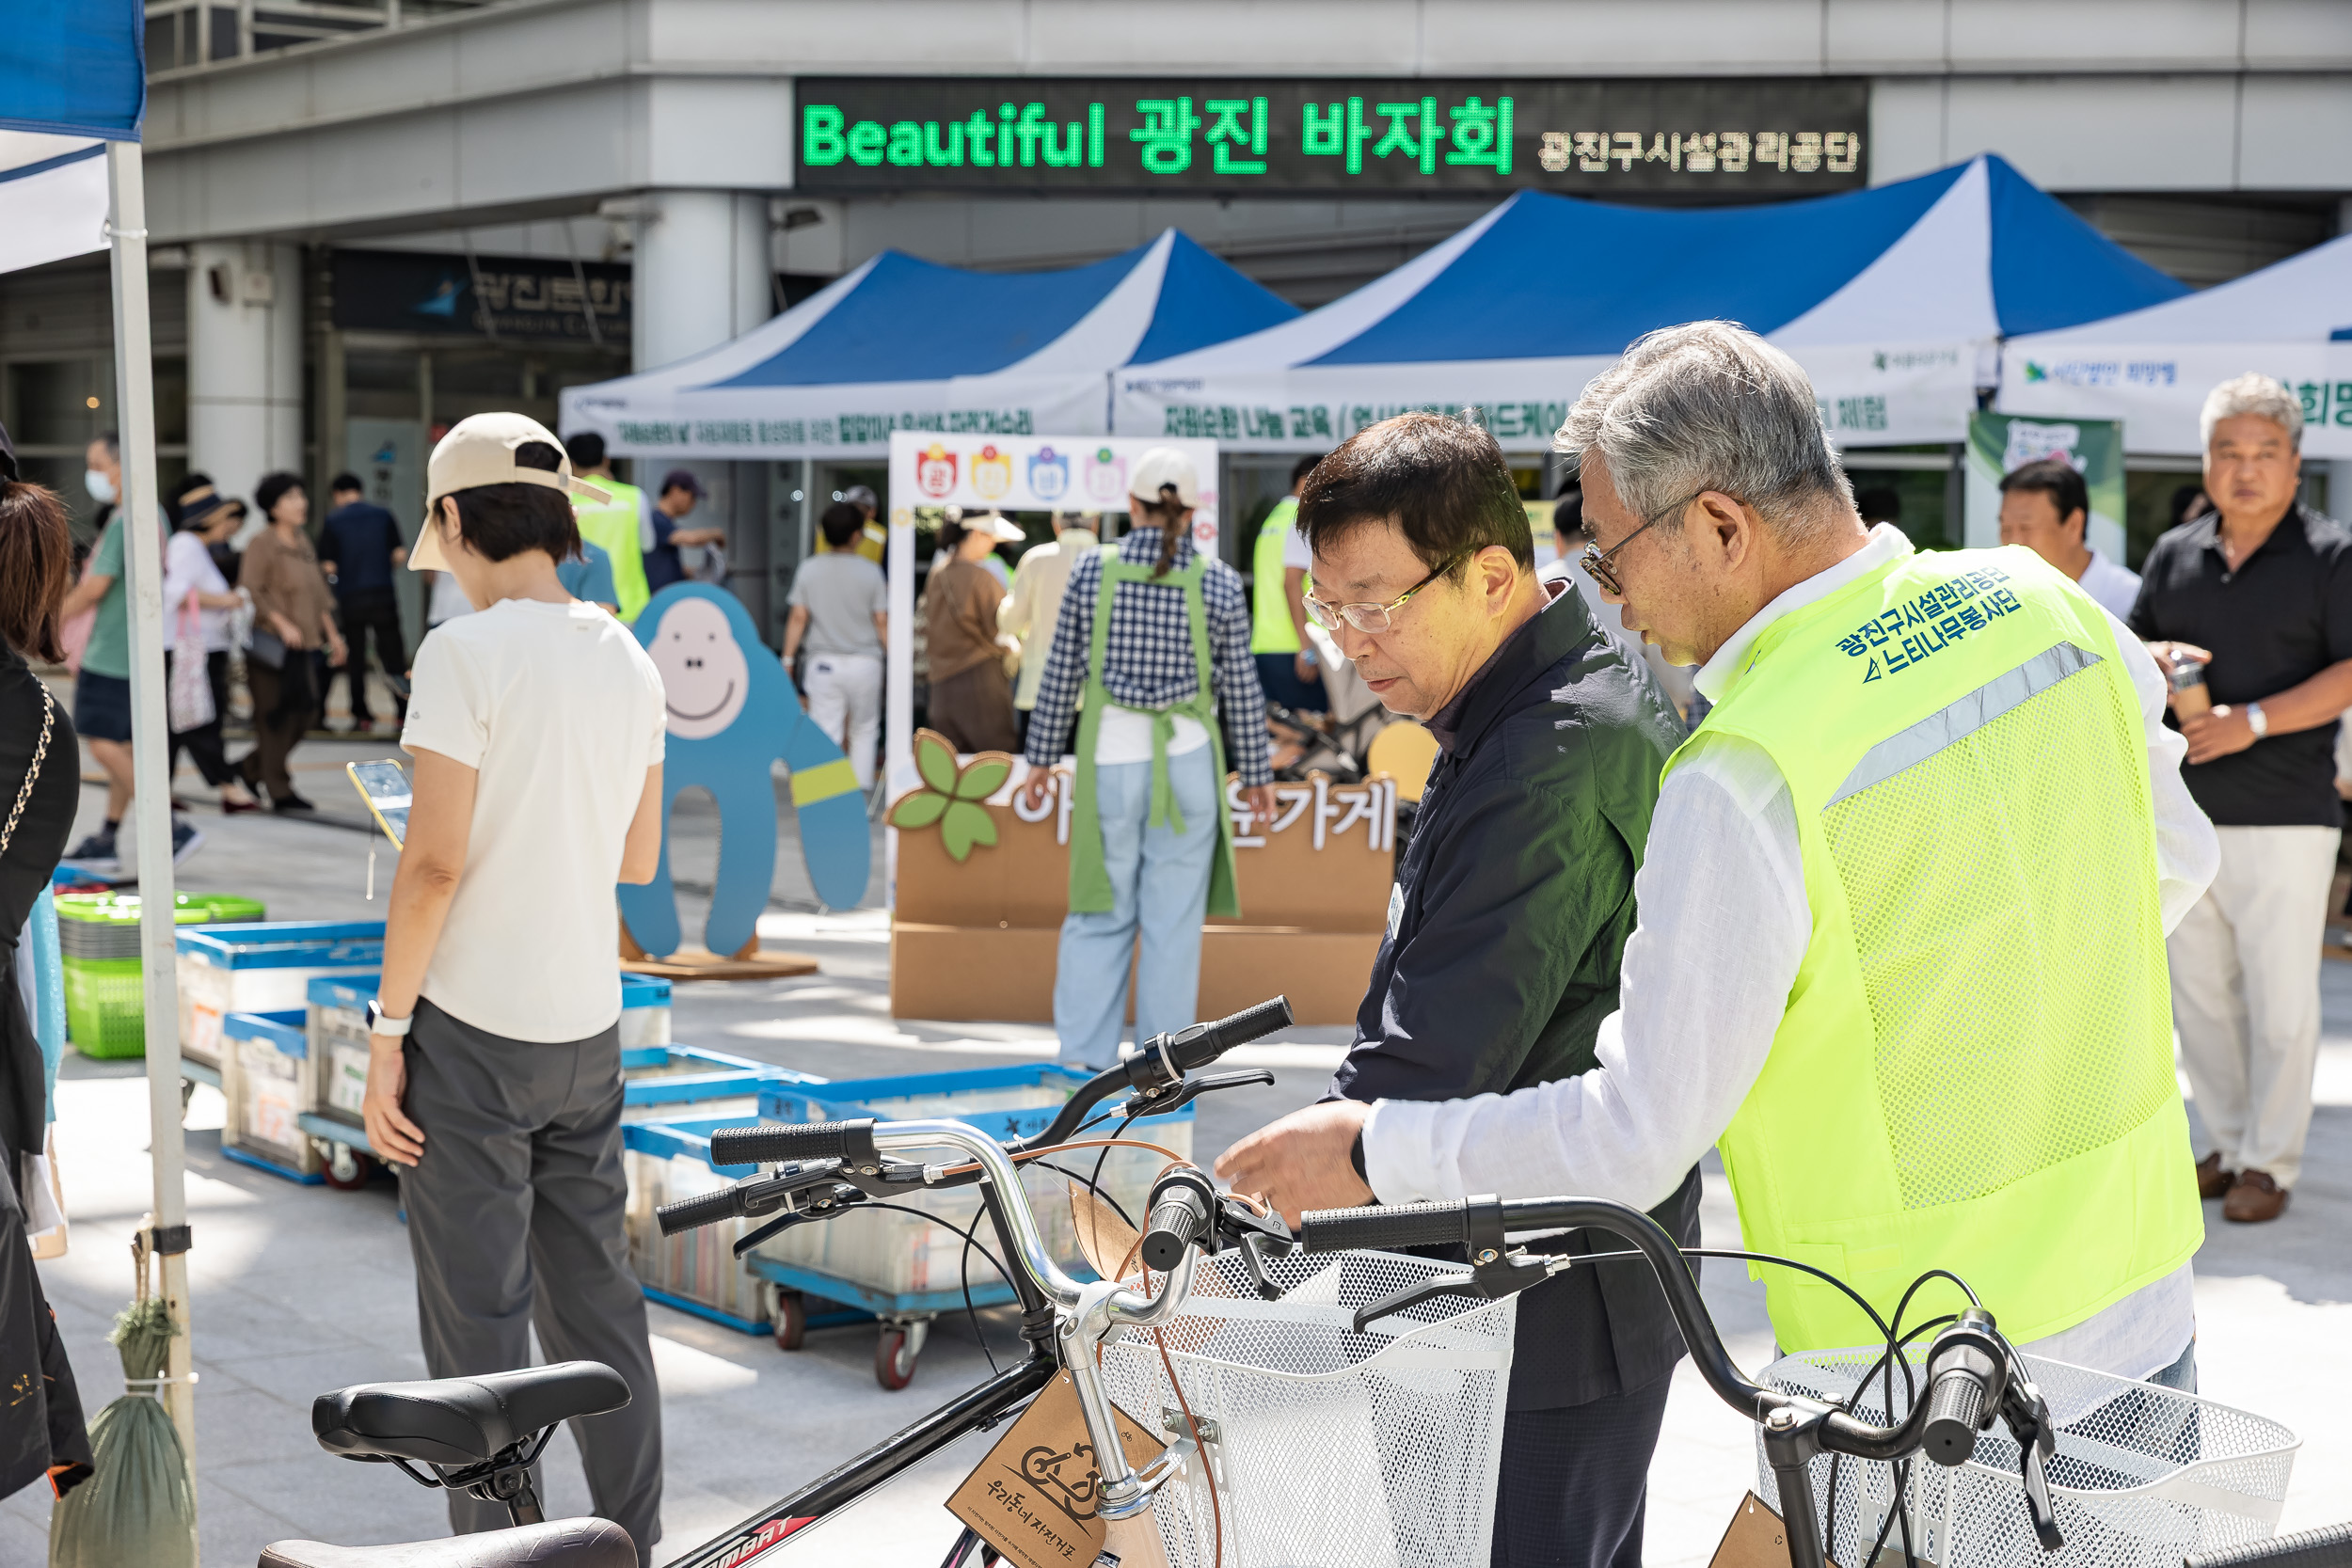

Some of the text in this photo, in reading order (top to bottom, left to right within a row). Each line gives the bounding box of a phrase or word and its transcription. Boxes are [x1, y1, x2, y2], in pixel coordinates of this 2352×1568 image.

[803, 96, 1862, 175] Beautiful 광진 바자회 광진구시설관리공단
[1835, 566, 2010, 657] 광진구시설관리공단
[1883, 587, 2022, 674] 느티나무봉사단
[986, 1480, 1077, 1562] 우리동네 자전거포
